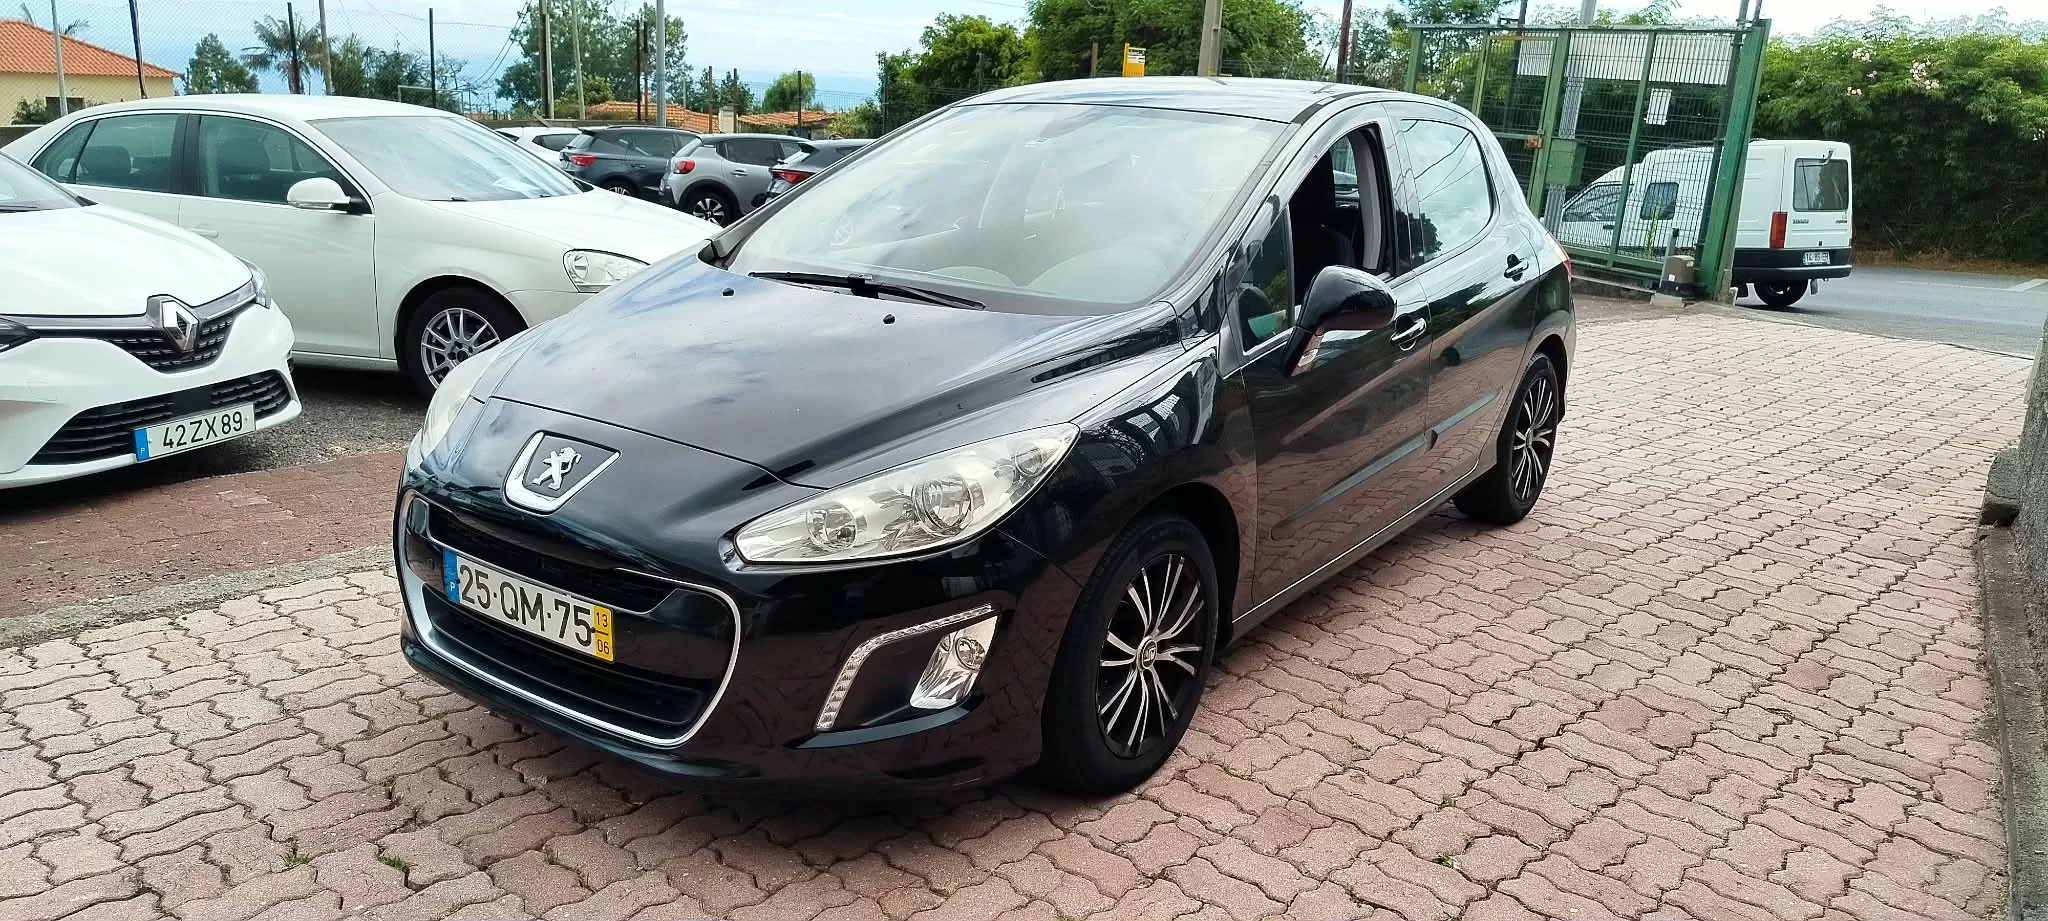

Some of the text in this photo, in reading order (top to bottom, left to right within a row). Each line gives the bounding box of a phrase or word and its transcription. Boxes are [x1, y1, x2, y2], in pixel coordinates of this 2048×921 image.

[450, 582, 456, 592] P
[596, 613, 608, 628] 13
[596, 639, 610, 655] 06
